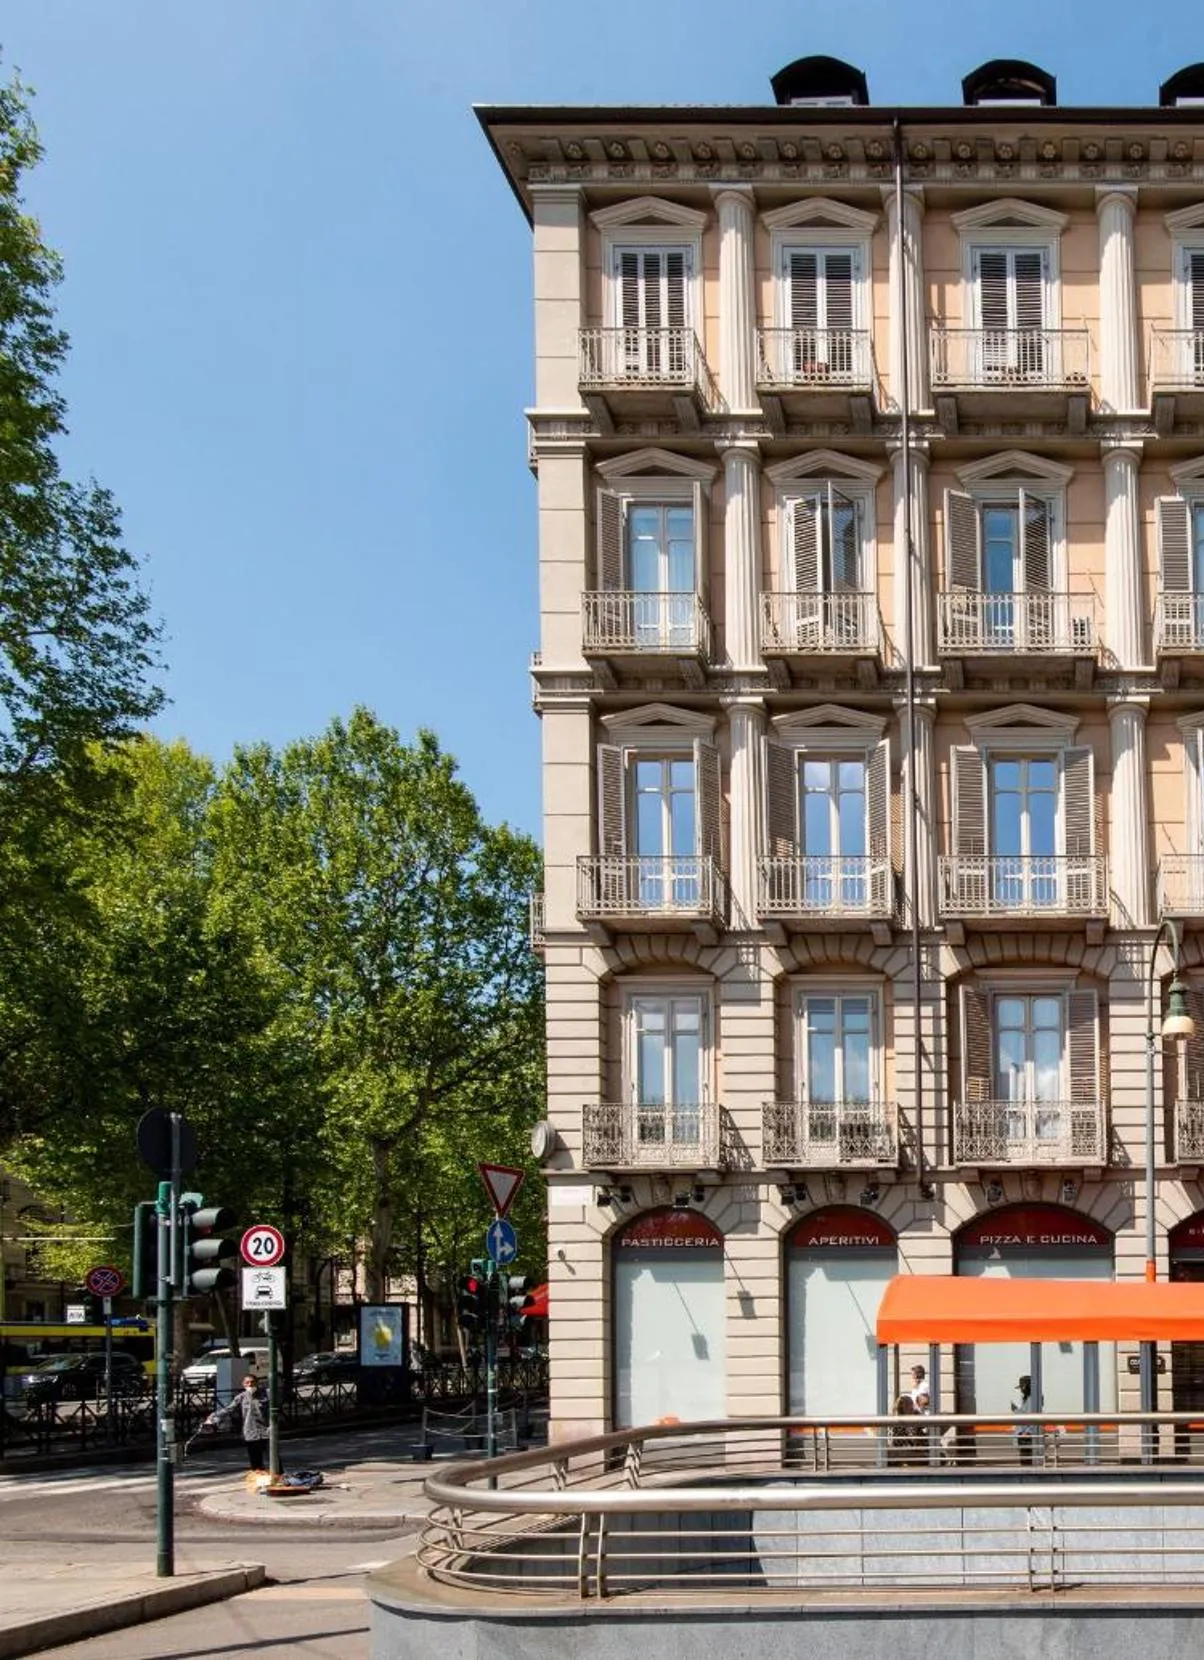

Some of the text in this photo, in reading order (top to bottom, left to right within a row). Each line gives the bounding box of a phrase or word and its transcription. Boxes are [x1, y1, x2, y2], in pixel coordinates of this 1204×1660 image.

[621, 1237, 720, 1248] PASTICCERIA
[808, 1235, 880, 1246] APERITIVI
[979, 1235, 1022, 1245] PIZZA
[1040, 1234, 1098, 1244] CUCINA
[252, 1236, 275, 1256] 20
